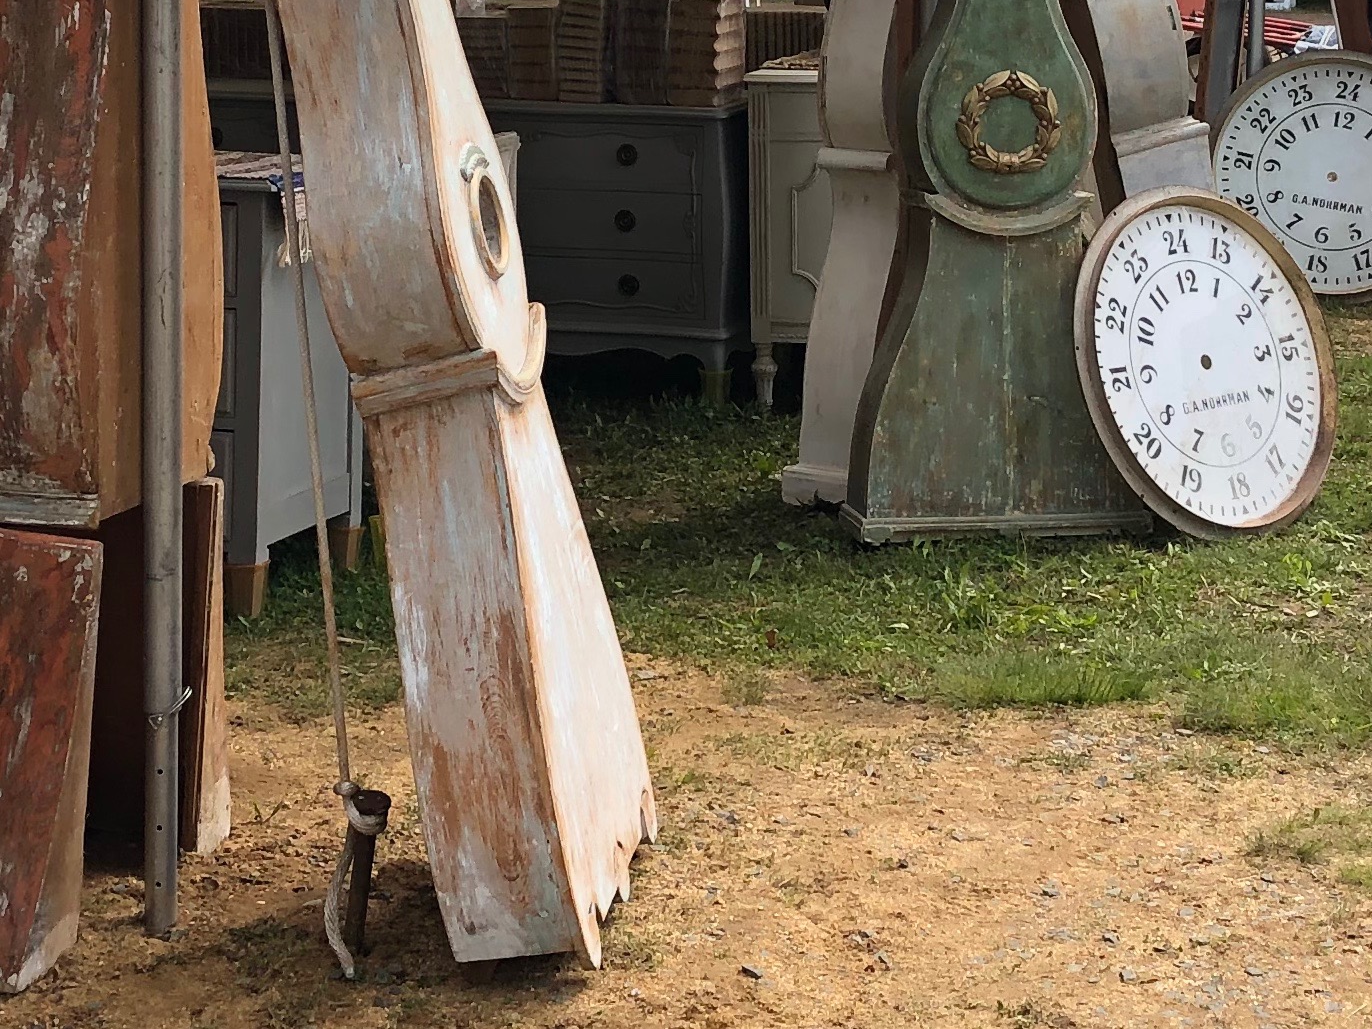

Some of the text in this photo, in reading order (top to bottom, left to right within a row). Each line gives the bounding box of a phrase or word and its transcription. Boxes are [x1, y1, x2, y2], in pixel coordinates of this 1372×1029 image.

[1287, 83, 1314, 107] 23
[1335, 80, 1362, 102] 24
[1250, 107, 1277, 134] 22
[1301, 112, 1320, 132] 11
[1333, 111, 1356, 130] 12
[1274, 128, 1297, 151] 10
[1234, 151, 1254, 170] 21
[1263, 158, 1281, 172] 9
[1266, 190, 1284, 204] 8
[1285, 213, 1304, 230] 7
[1348, 222, 1362, 242] 5
[1163, 228, 1191, 256] 24
[1314, 226, 1329, 244] 6
[1211, 236, 1232, 265] 13
[1351, 248, 1372, 272] 17
[1124, 249, 1149, 284] 23
[1307, 254, 1328, 273] 18
[1176, 269, 1199, 295] 12
[1213, 277, 1221, 299] 1
[1250, 273, 1274, 305] 14
[1149, 284, 1170, 313] 11
[1106, 297, 1128, 334] 22
[1236, 303, 1253, 325] 2
[1137, 316, 1156, 347] 10
[1253, 345, 1272, 362] 3
[1278, 333, 1299, 362] 15
[1112, 365, 1132, 393] 21
[1140, 364, 1158, 385] 9
[1257, 384, 1275, 404] 4
[1159, 404, 1175, 426] 8
[1285, 394, 1304, 428] 16
[1248, 414, 1263, 439] 5
[1133, 422, 1162, 460] 20
[1191, 428, 1205, 454] 7
[1220, 432, 1237, 458] 6
[1265, 443, 1287, 476] 17
[1180, 464, 1203, 493] 19
[1228, 472, 1251, 500] 18
